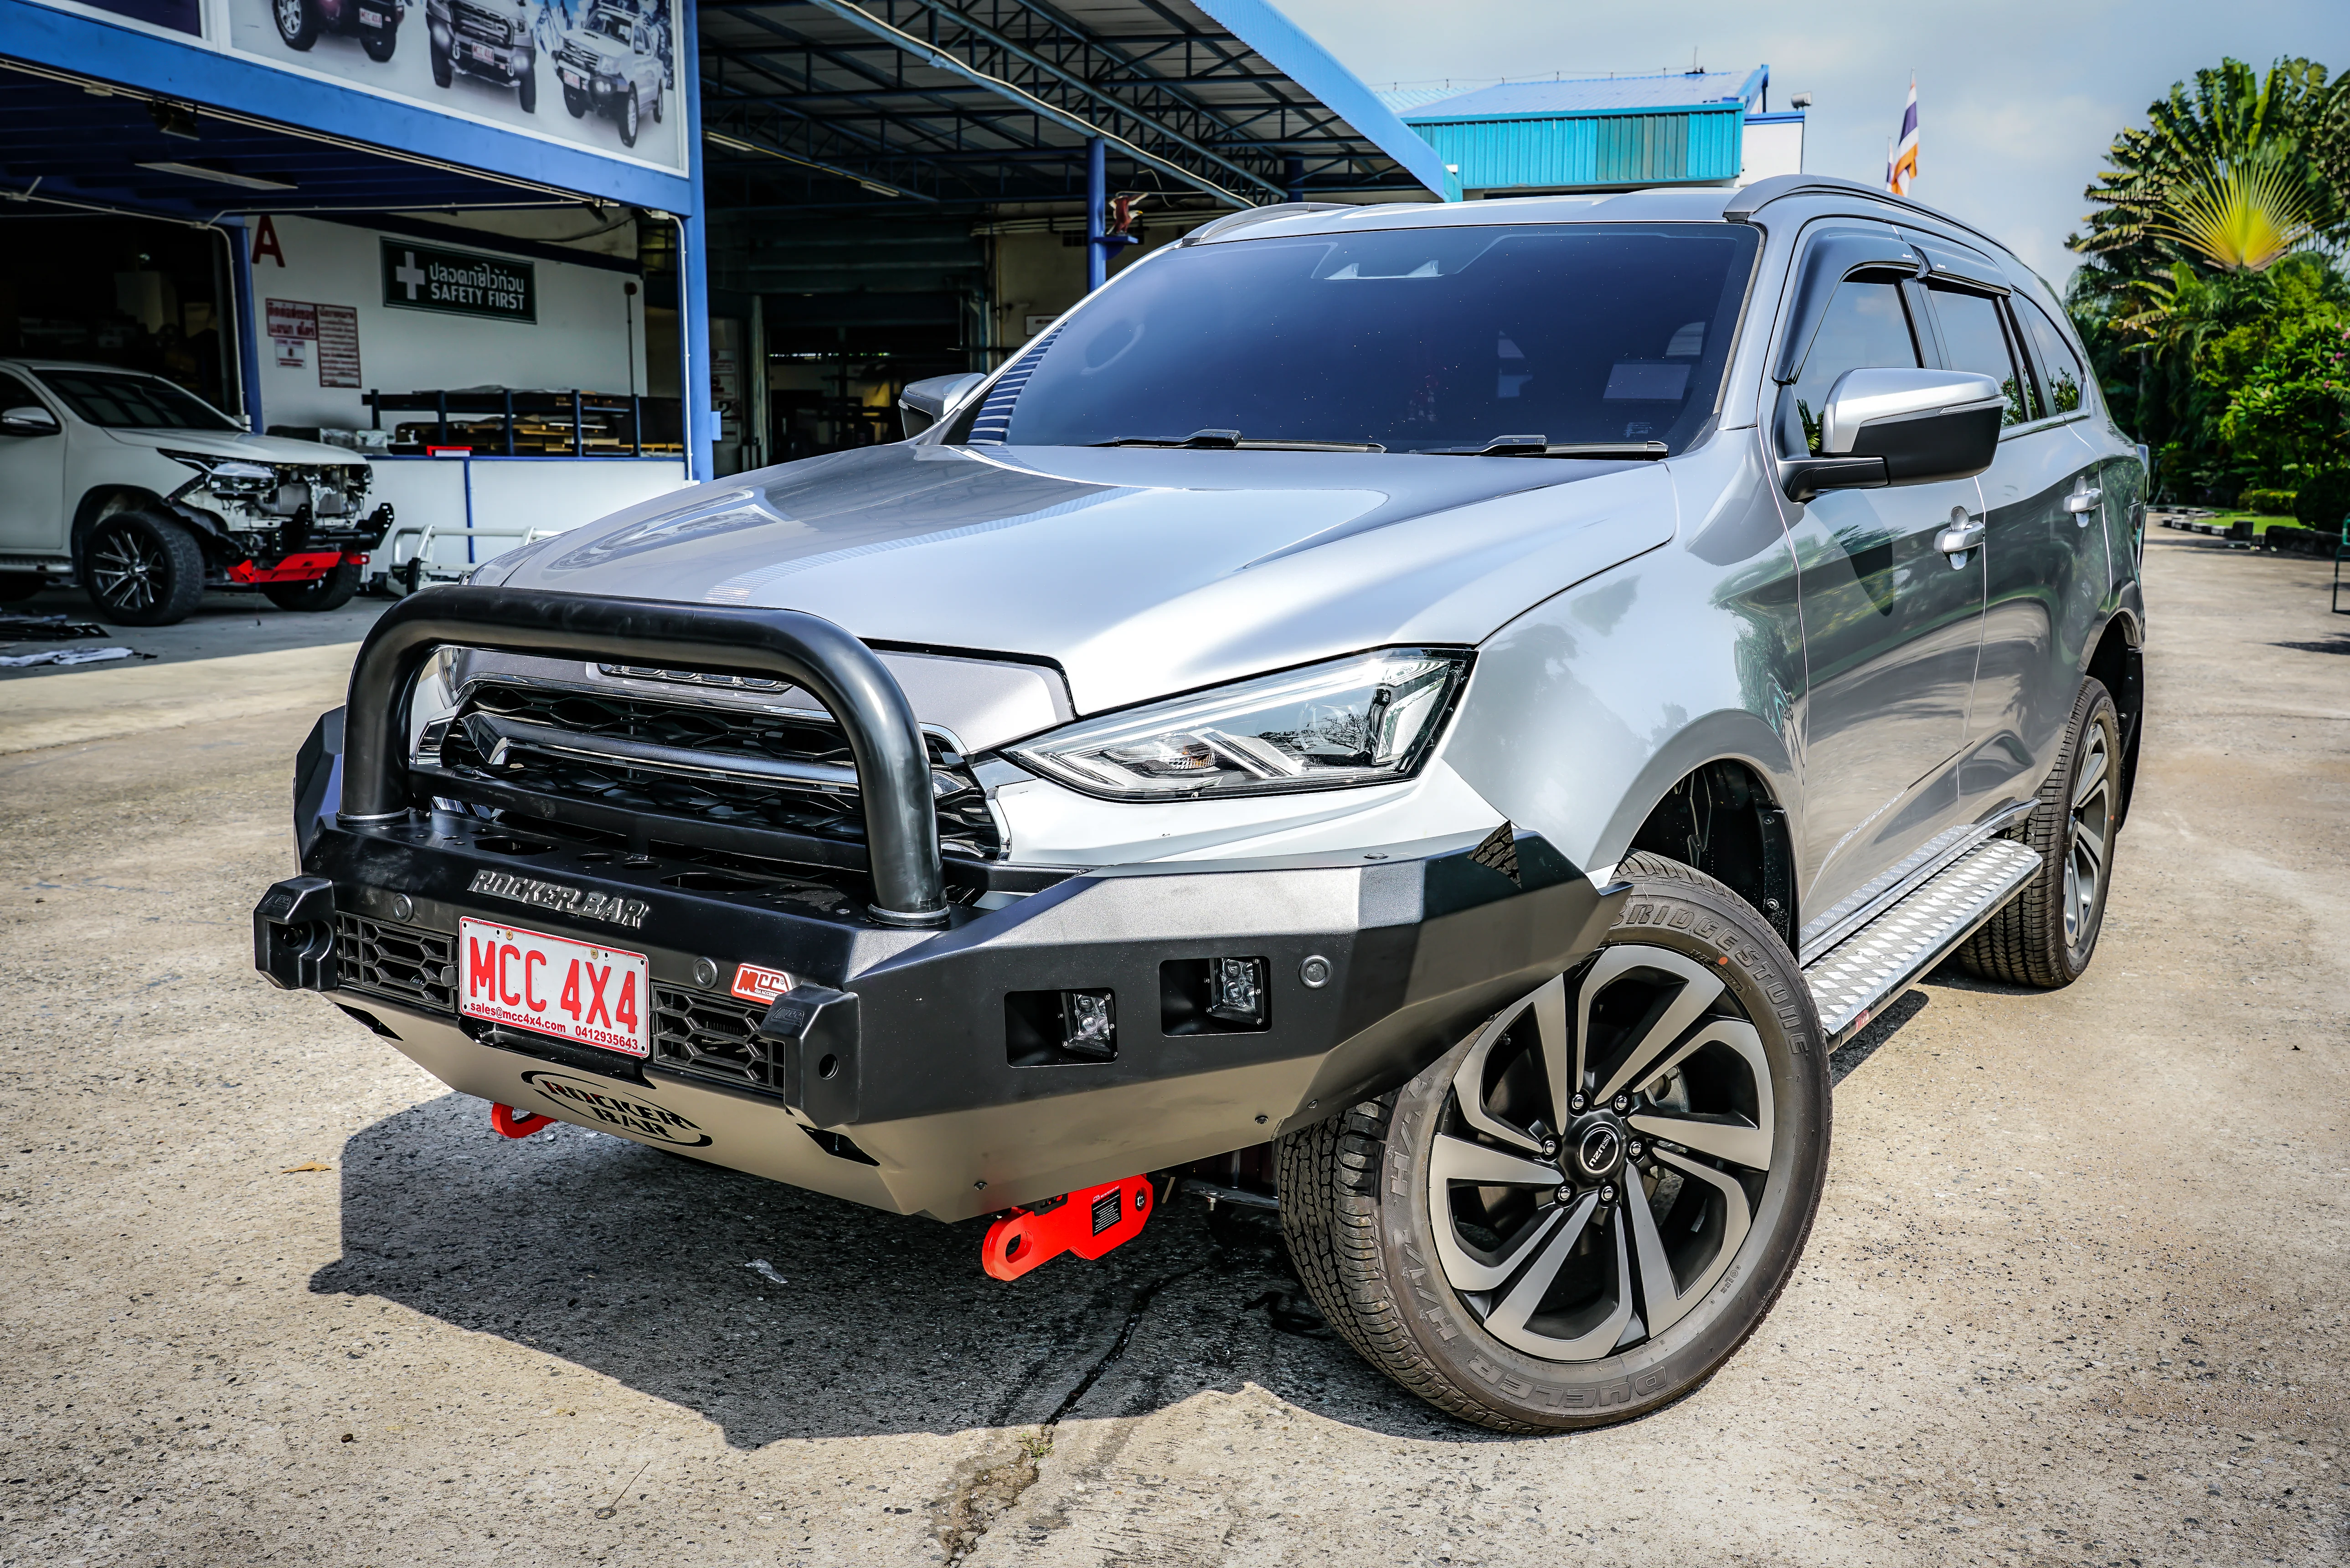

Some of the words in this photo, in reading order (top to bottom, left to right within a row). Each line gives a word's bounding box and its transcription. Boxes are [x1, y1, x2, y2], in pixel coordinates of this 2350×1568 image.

[252, 214, 286, 268] A
[430, 262, 524, 293] ปลอดภัยไว้ก่อน
[431, 283, 483, 304] SAFETY
[488, 291, 524, 310] FIRST
[467, 869, 581, 911] ROCKER
[583, 892, 649, 928] BAR
[470, 936, 546, 1012] MCC
[561, 959, 638, 1034] 4X4
[470, 1002, 566, 1033] sales@mcc4x4.com
[575, 1026, 638, 1050] 0412935643
[538, 1078, 691, 1130] ROCKER
[588, 1105, 676, 1140] BAR
[1589, 1134, 1611, 1167] ISUZU
[1469, 1355, 1667, 1408] DUELER
